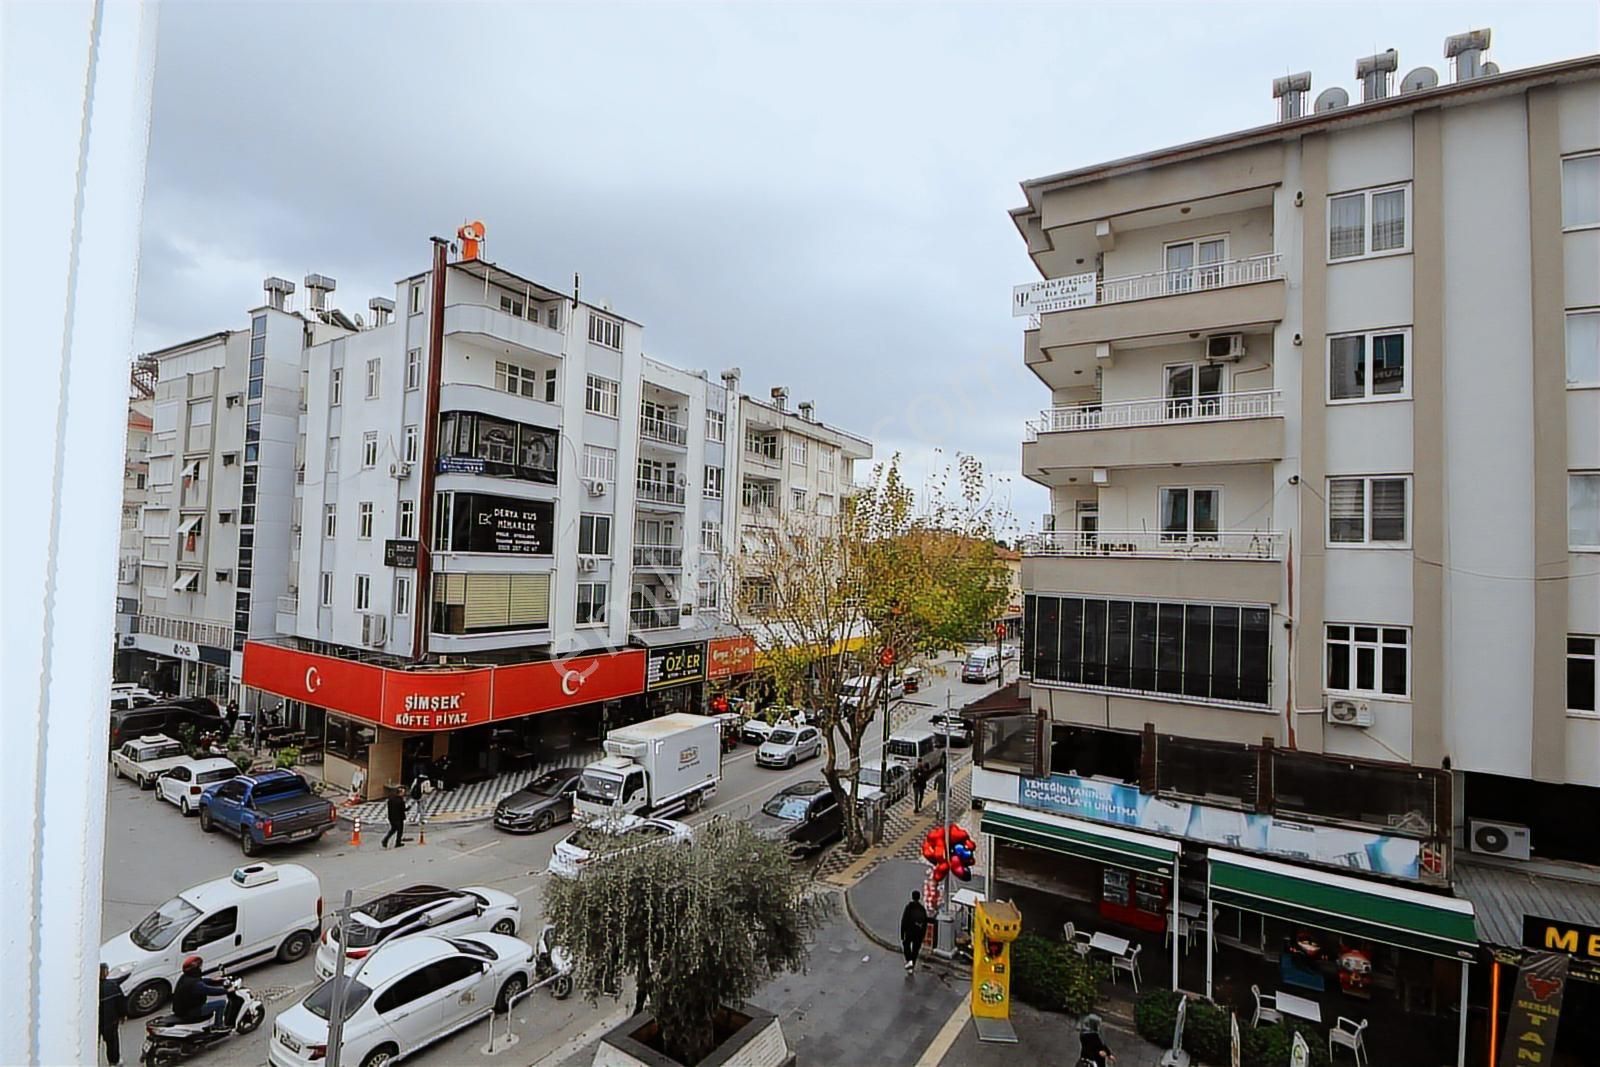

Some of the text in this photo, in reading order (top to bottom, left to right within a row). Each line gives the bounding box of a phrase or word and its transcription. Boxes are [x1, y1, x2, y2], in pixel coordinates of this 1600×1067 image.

[405, 692, 460, 711] ŞİMŞEK
[395, 712, 468, 726] KÖFTE PİYAZ
